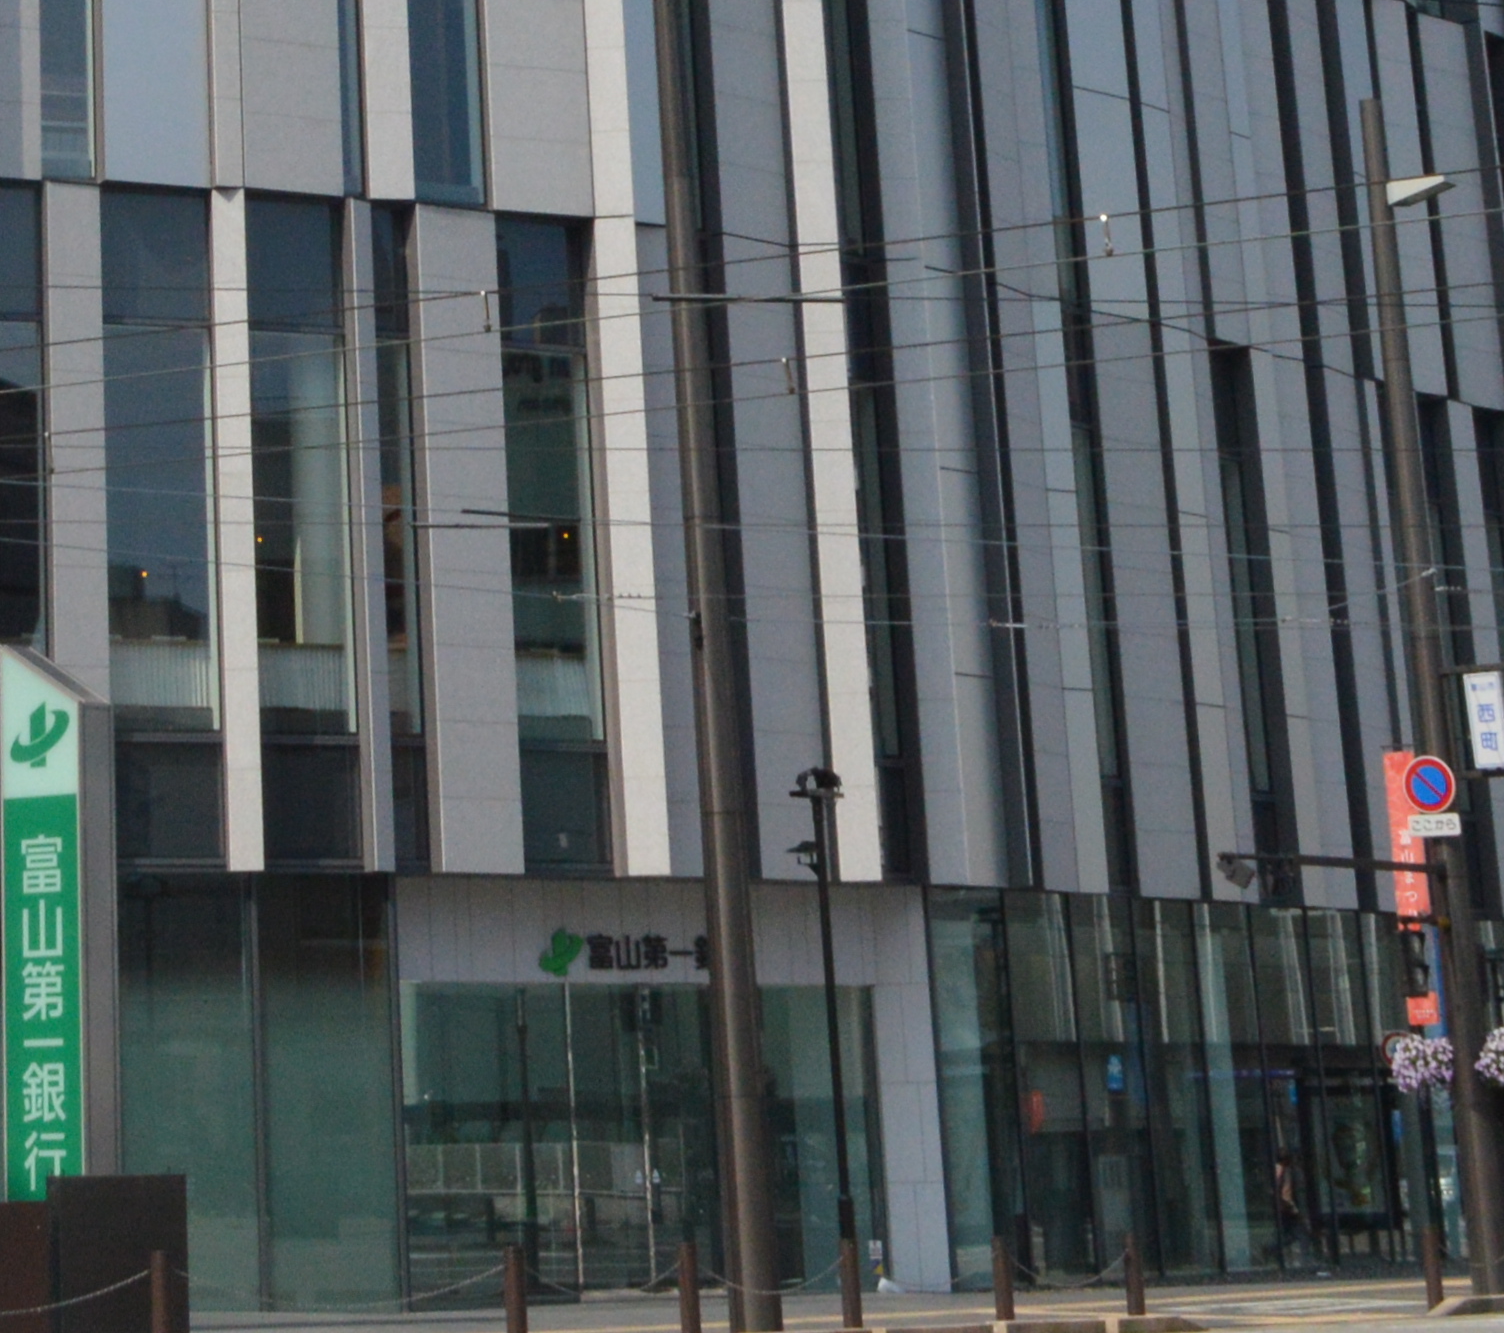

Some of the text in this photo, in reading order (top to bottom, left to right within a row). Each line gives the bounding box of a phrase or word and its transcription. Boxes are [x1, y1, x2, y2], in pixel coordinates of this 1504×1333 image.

[1476, 703, 1499, 751] 西町
[1411, 817, 1458, 834] ここから
[20, 834, 67, 1192] 富山第一銀行
